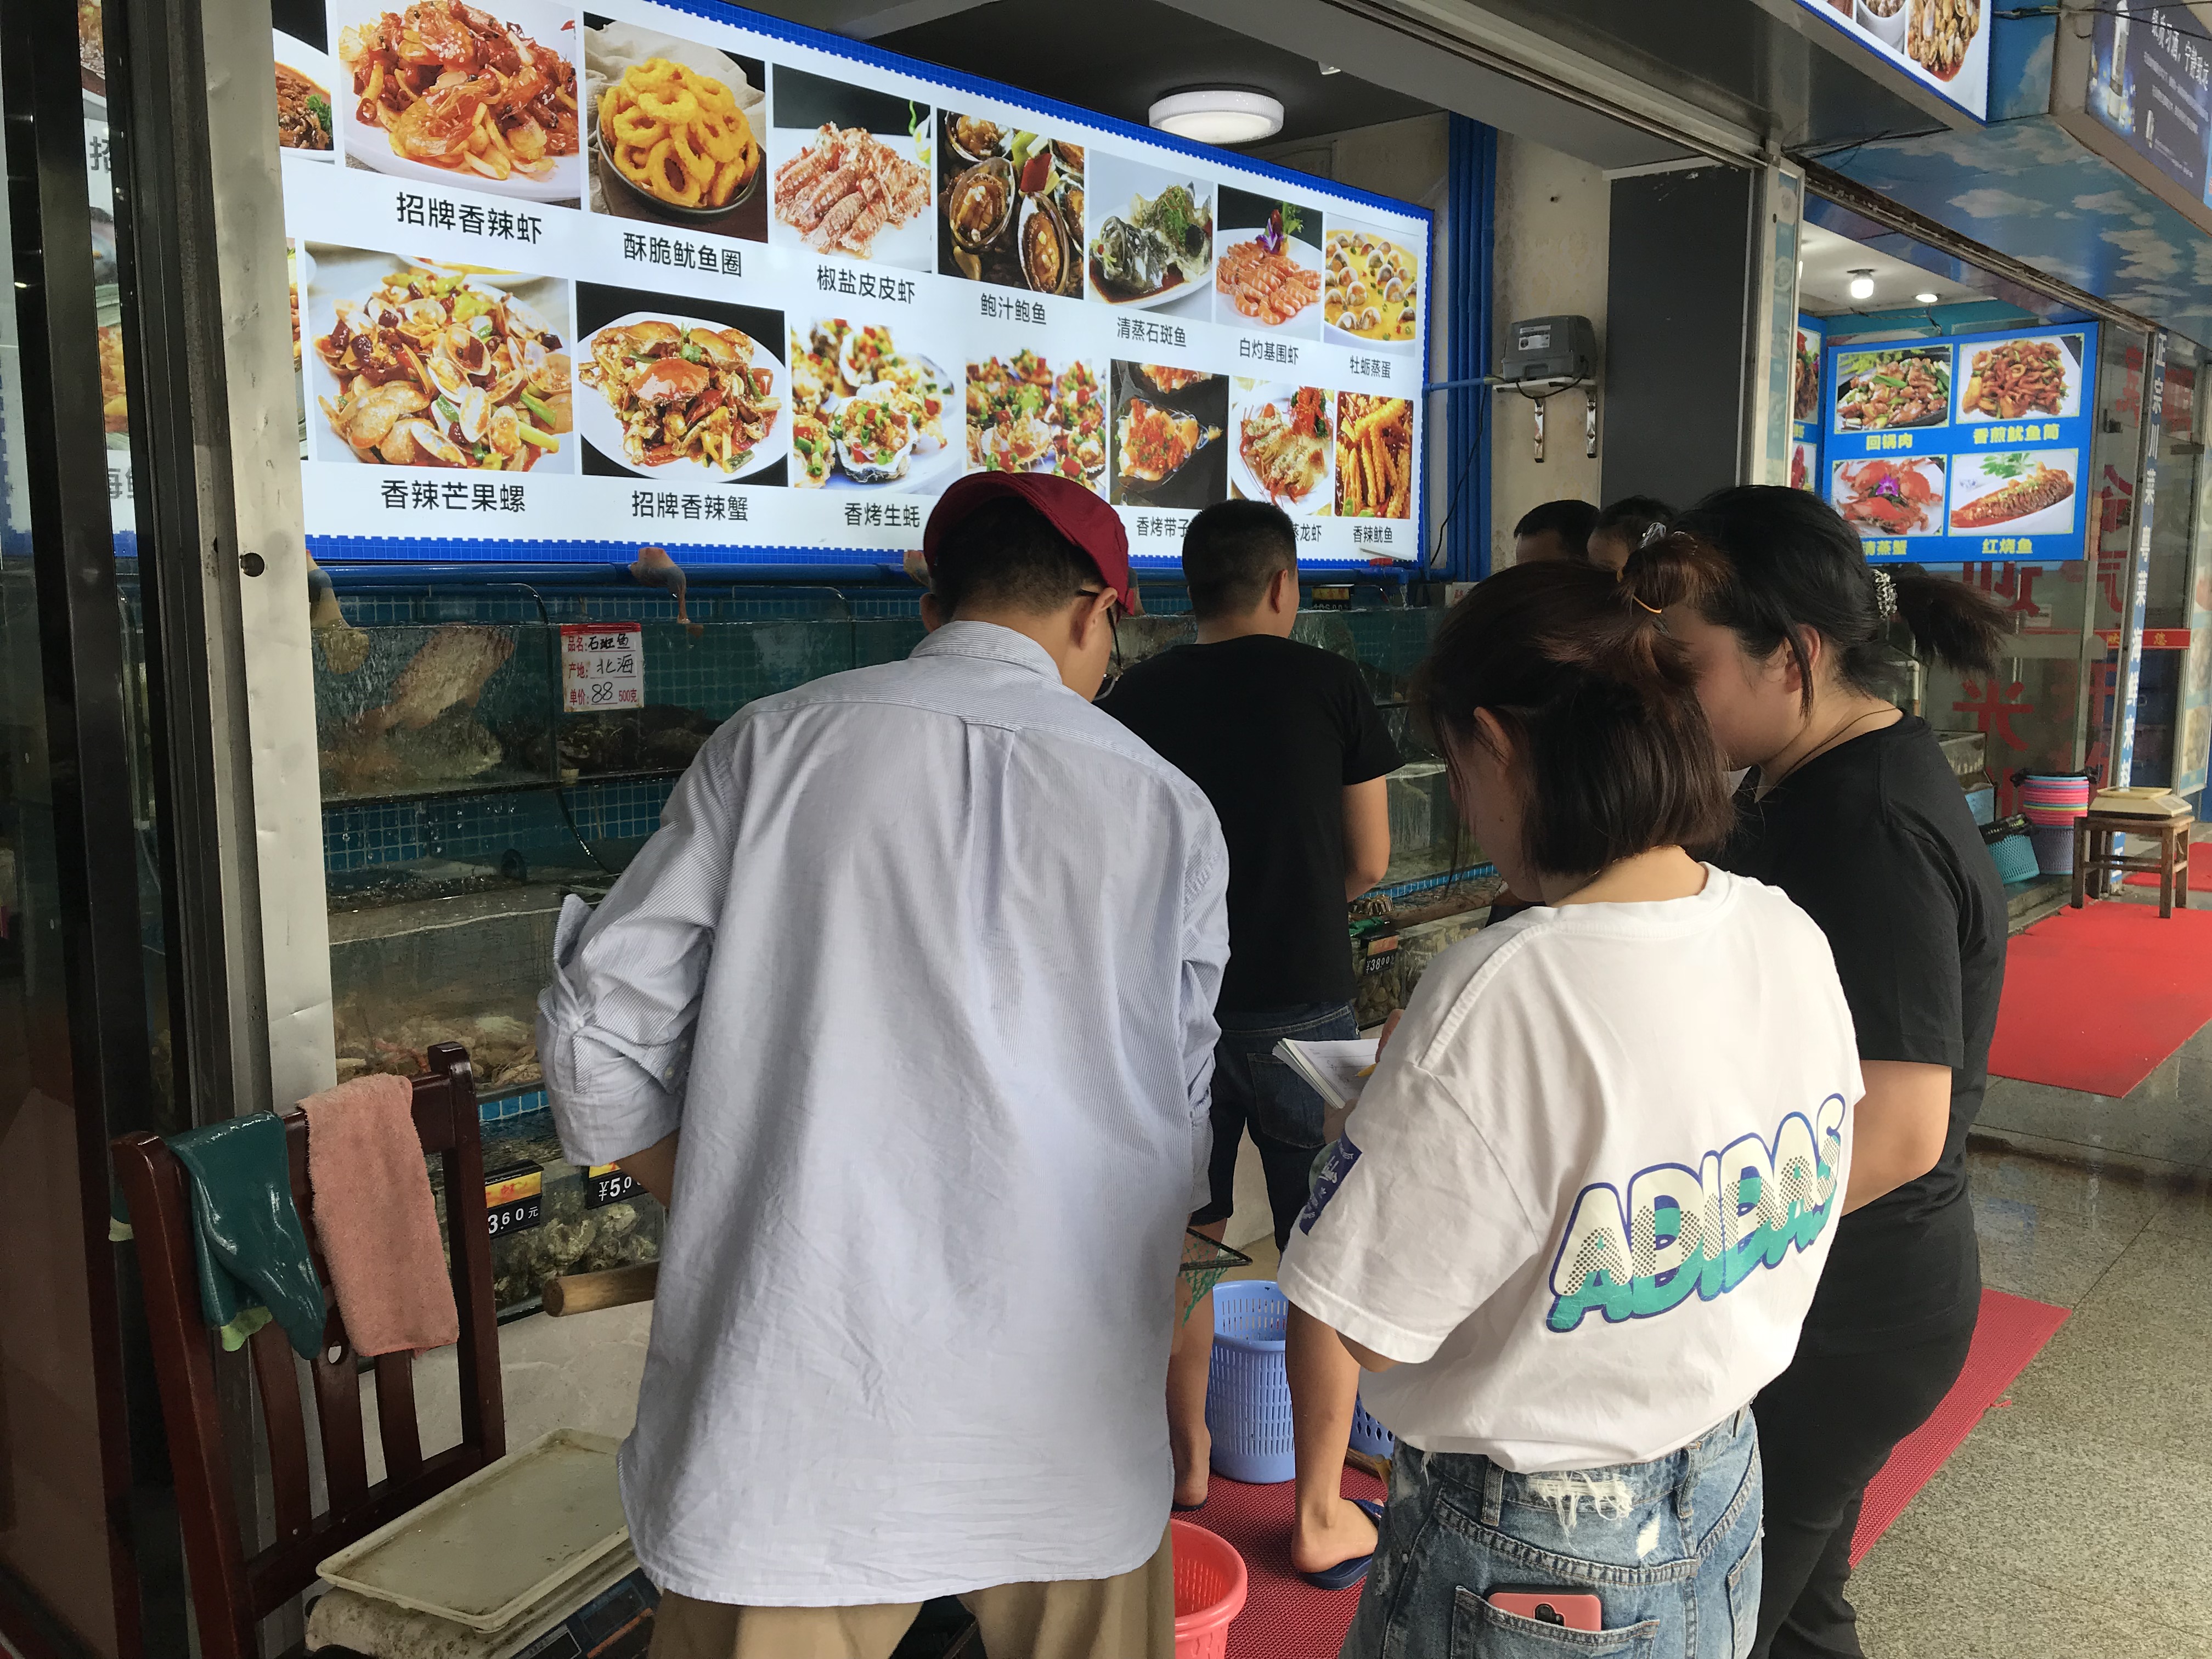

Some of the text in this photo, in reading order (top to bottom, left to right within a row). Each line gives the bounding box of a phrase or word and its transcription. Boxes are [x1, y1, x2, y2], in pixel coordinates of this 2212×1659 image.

[396, 192, 542, 245] 招牌香辣虾
[623, 232, 742, 277] 酥脆鱿鱼圈
[816, 264, 916, 304] 椒盐皮皮虾
[980, 293, 1047, 326] 鲍汁鲍鱼
[1117, 317, 1187, 348] 清蒸石斑鱼
[1239, 338, 1299, 365] 白灼基围虾
[1350, 355, 1391, 379] 牡蛎蒸蛋
[1866, 433, 1913, 450] 回锅肉
[380, 479, 525, 513] 香辣芒果螺
[631, 490, 749, 522] 招牌香辣蟹
[844, 502, 921, 533] 香烤生蚝
[1352, 525, 1393, 544] 香辣鱿鱼
[1982, 538, 2033, 555] 红烧鱼
[596, 654, 634, 674] 北海
[591, 682, 613, 703] 88
[618, 688, 637, 703] 500克
[598, 1176, 641, 1201] ¥5.0
[1545, 1092, 1847, 1333] ADIDAS
